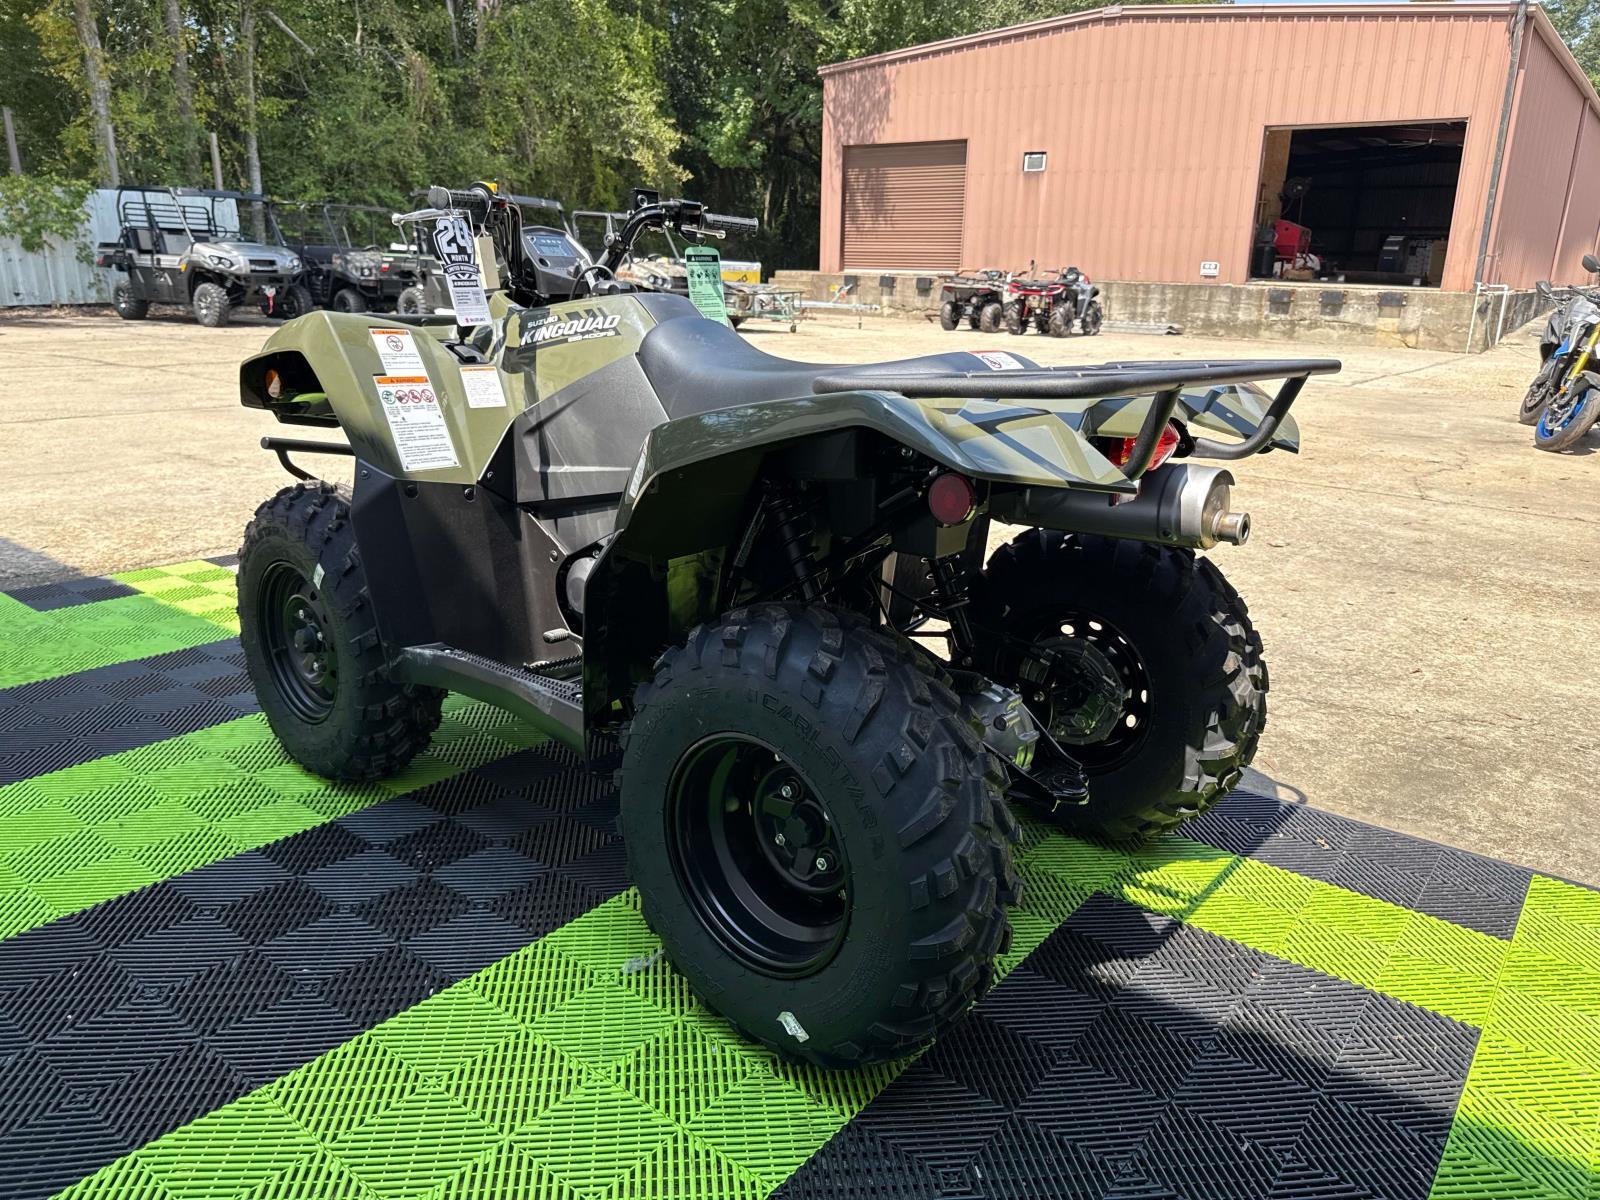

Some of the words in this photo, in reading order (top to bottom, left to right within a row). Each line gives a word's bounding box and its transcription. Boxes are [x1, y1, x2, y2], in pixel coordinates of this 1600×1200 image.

[437, 217, 473, 254] 24
[520, 314, 621, 346] KINGQUAD
[527, 315, 559, 328] SUZUKI
